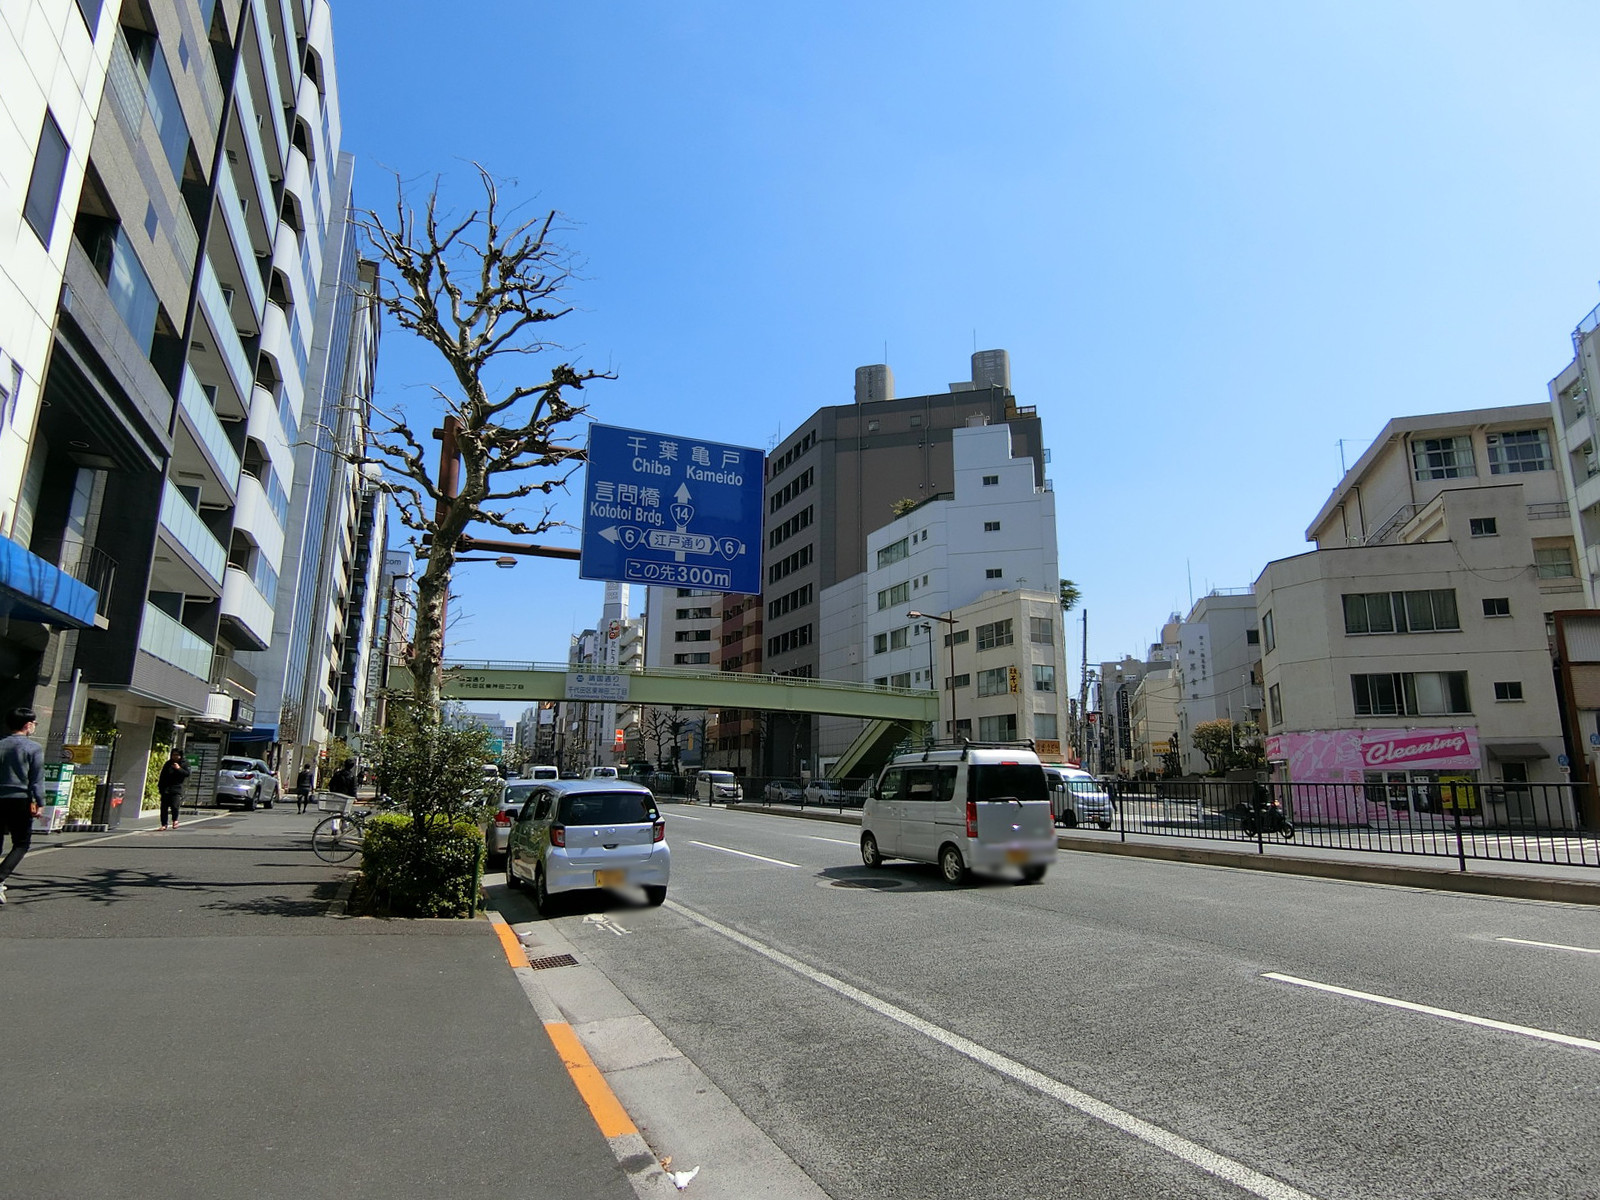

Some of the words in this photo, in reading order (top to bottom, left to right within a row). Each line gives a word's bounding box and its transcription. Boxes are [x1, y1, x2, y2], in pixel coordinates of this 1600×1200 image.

[627, 436, 678, 462] 千葉
[691, 446, 740, 469] 亀戸
[632, 457, 671, 476] Chiba
[686, 465, 743, 487] Kameido
[595, 481, 660, 508] 言問橋
[590, 502, 632, 520] Kototoi
[635, 507, 665, 527] Brdg.
[675, 507, 689, 521] 14
[625, 529, 635, 543] 6
[654, 534, 706, 550] 江戸通り
[724, 541, 734, 554] 6
[628, 561, 730, 586] この先300m
[367, 652, 379, 694] CENTPIA
[1366, 736, 1466, 764] Cleaning
